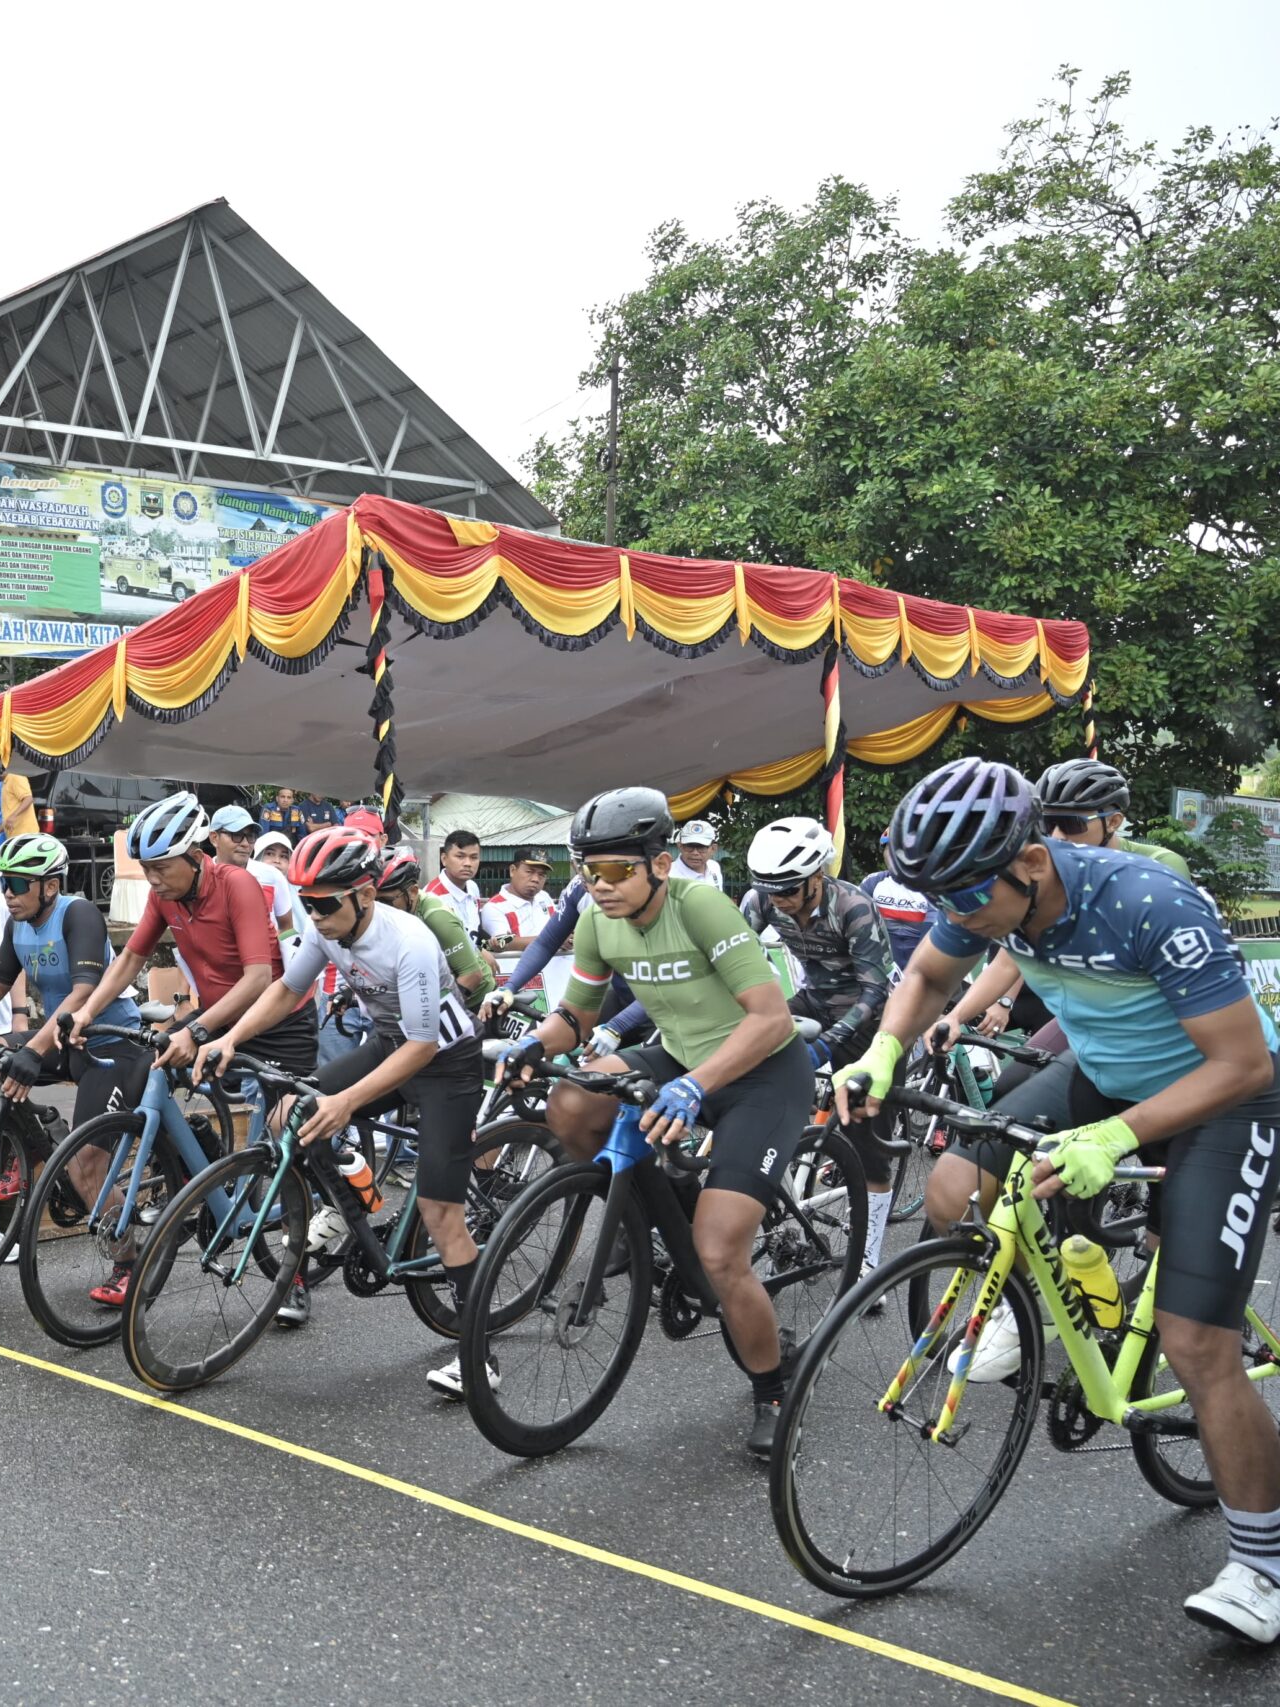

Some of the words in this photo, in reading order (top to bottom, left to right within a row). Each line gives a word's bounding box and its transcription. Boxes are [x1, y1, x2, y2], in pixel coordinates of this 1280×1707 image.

[19, 499, 89, 516] WASPADALAH
[218, 493, 260, 513] Jangan
[39, 515, 100, 531] KEBAKARAN
[218, 527, 238, 539] TAPI
[239, 529, 289, 544] SIMPANLAH
[29, 621, 86, 644] KAWAN
[89, 624, 120, 646] KITA
[444, 941, 465, 957] O.CC
[710, 932, 750, 962] JO.CC
[623, 960, 692, 982] JO.CC
[418, 971, 430, 1028] FINISHER
[760, 1147, 778, 1175] MBO
[1220, 1121, 1275, 1271] JO.CC
